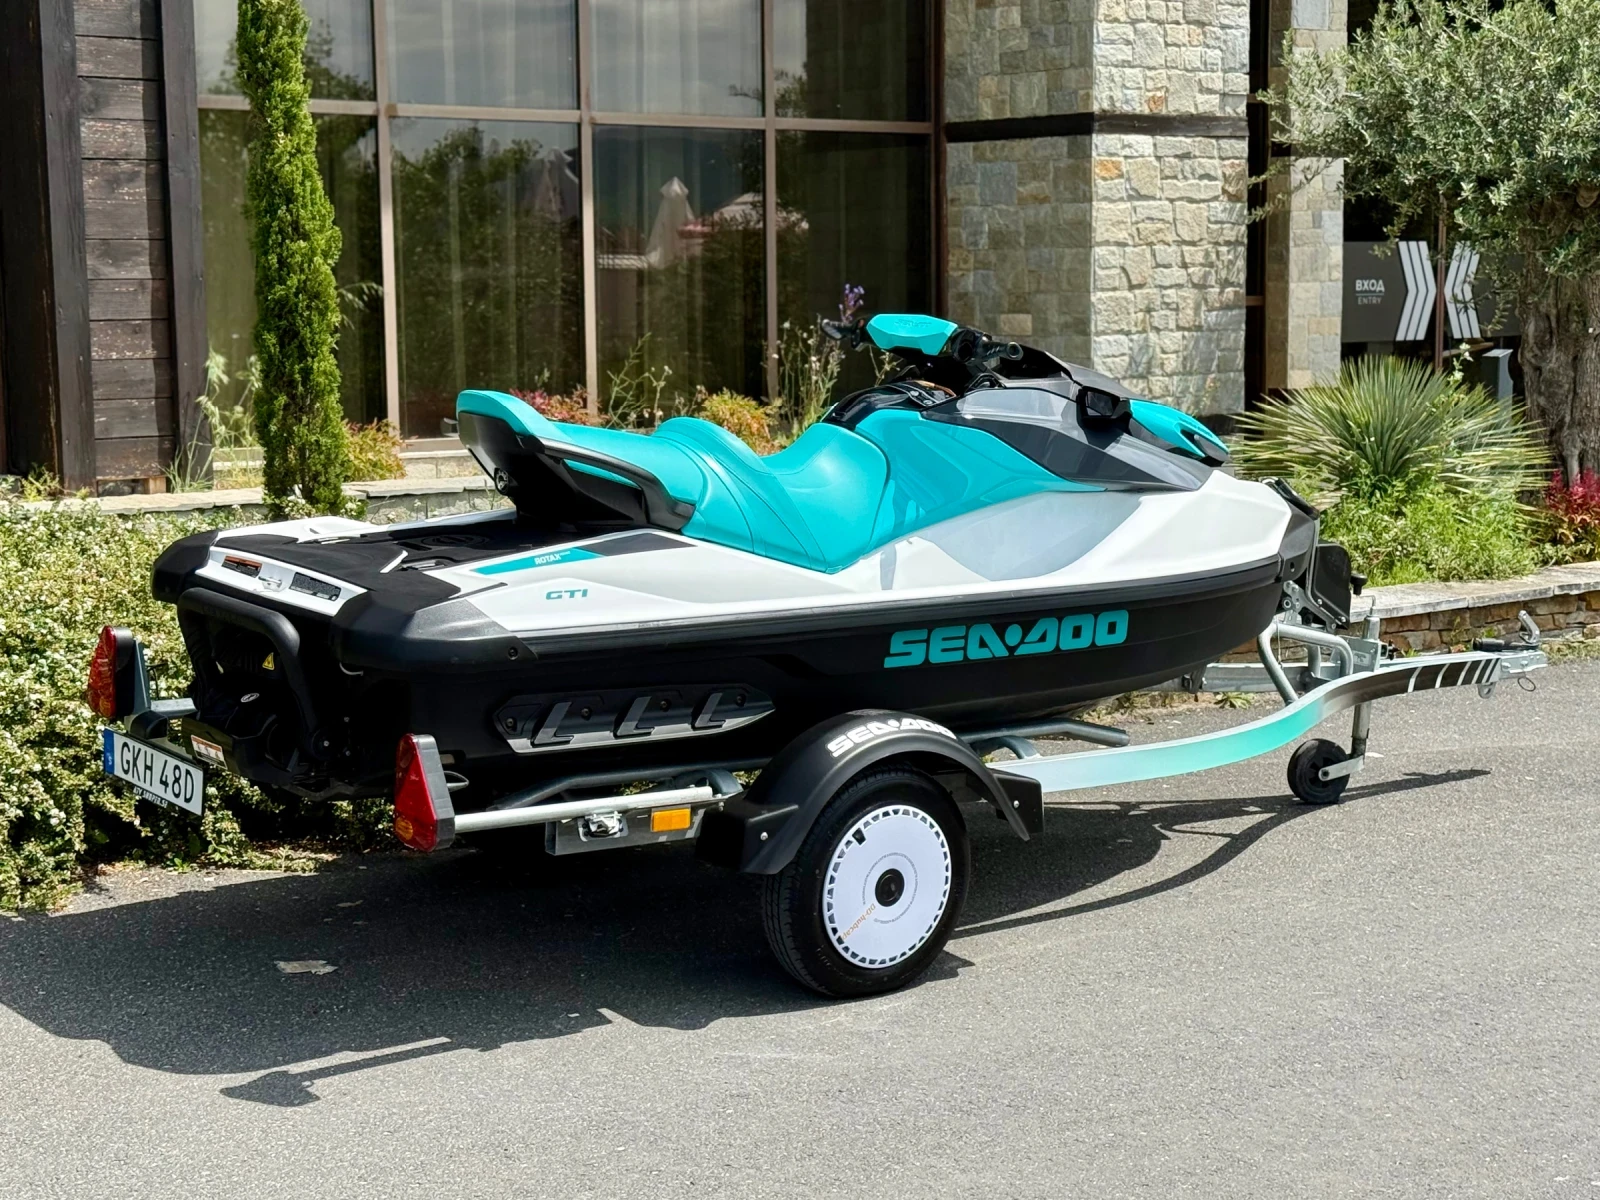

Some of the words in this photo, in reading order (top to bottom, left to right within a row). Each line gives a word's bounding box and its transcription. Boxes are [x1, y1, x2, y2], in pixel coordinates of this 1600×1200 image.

[1355, 279, 1385, 293] ВХОД
[1358, 296, 1381, 304] ENTRY
[534, 553, 561, 564] ROTAX
[545, 588, 588, 600] GTI
[121, 741, 154, 787] GKH
[159, 759, 195, 804] 48D
